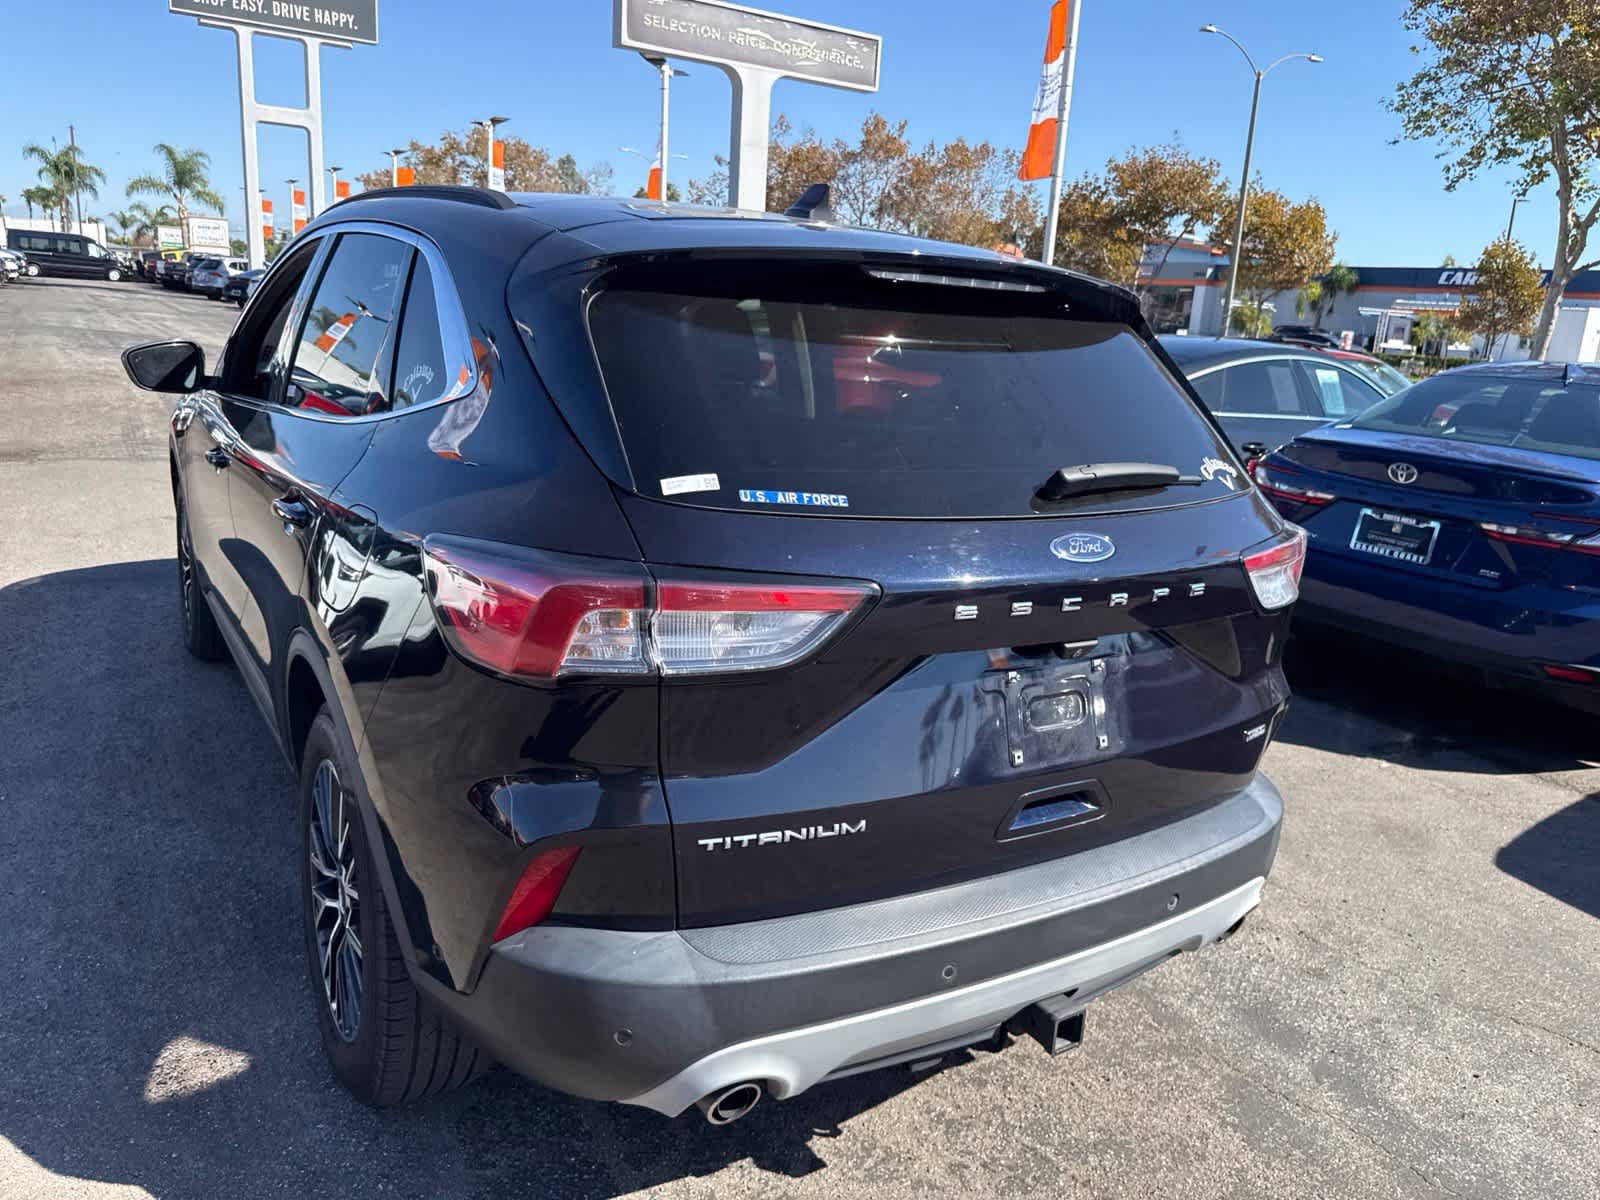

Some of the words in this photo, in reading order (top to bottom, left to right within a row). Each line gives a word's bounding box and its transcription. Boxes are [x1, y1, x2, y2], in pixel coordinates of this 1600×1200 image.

[232, 0, 268, 14] EASY.
[272, 1, 310, 21] DRIVE
[314, 8, 358, 29] HAPPY.
[739, 489, 770, 503] U.S.
[776, 491, 799, 505] AIR
[801, 493, 849, 507] FORCE
[954, 582, 1206, 620] ESCAPE
[697, 819, 867, 851] TITANIUM
